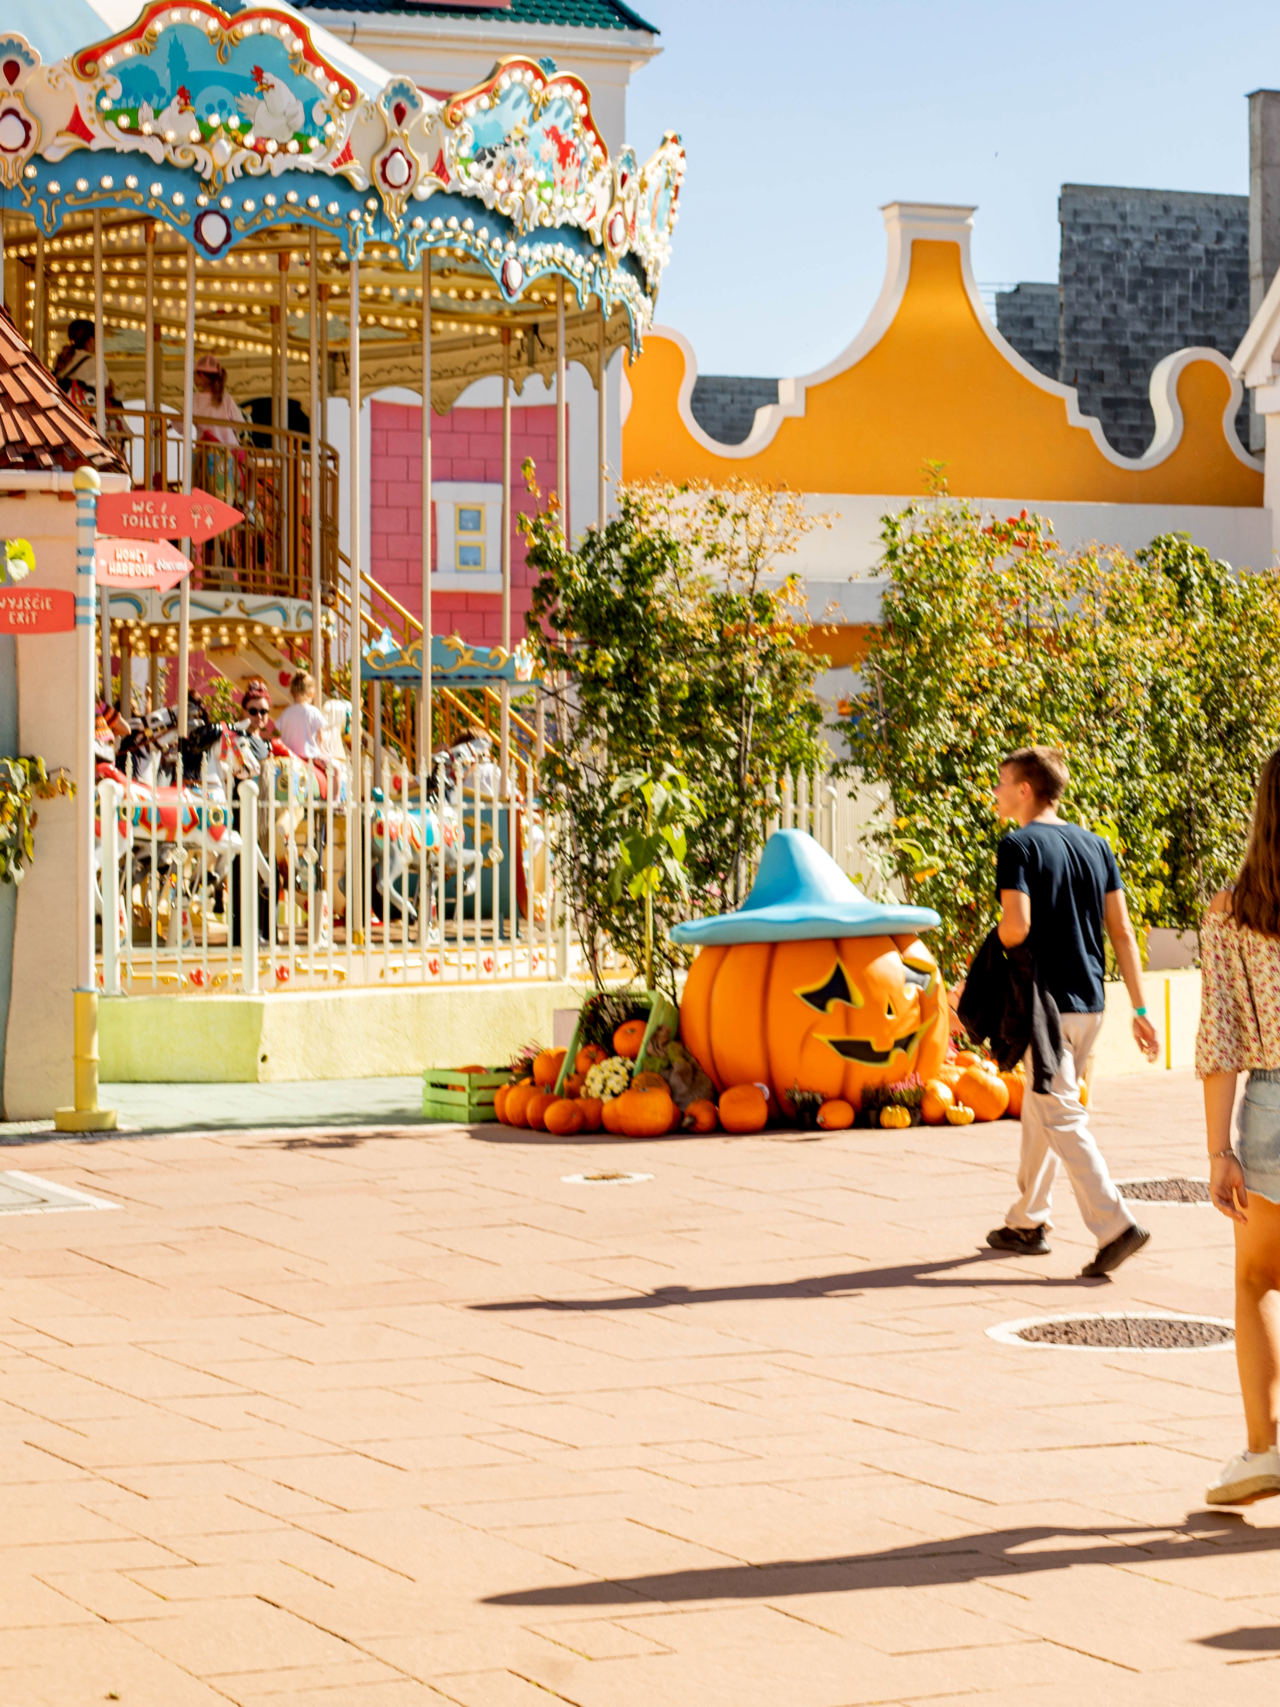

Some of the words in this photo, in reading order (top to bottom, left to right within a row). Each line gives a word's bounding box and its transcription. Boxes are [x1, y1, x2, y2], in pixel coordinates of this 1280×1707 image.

[132, 500, 155, 514] WC
[115, 547, 149, 563] HONEY
[107, 560, 156, 578] HARBOUR
